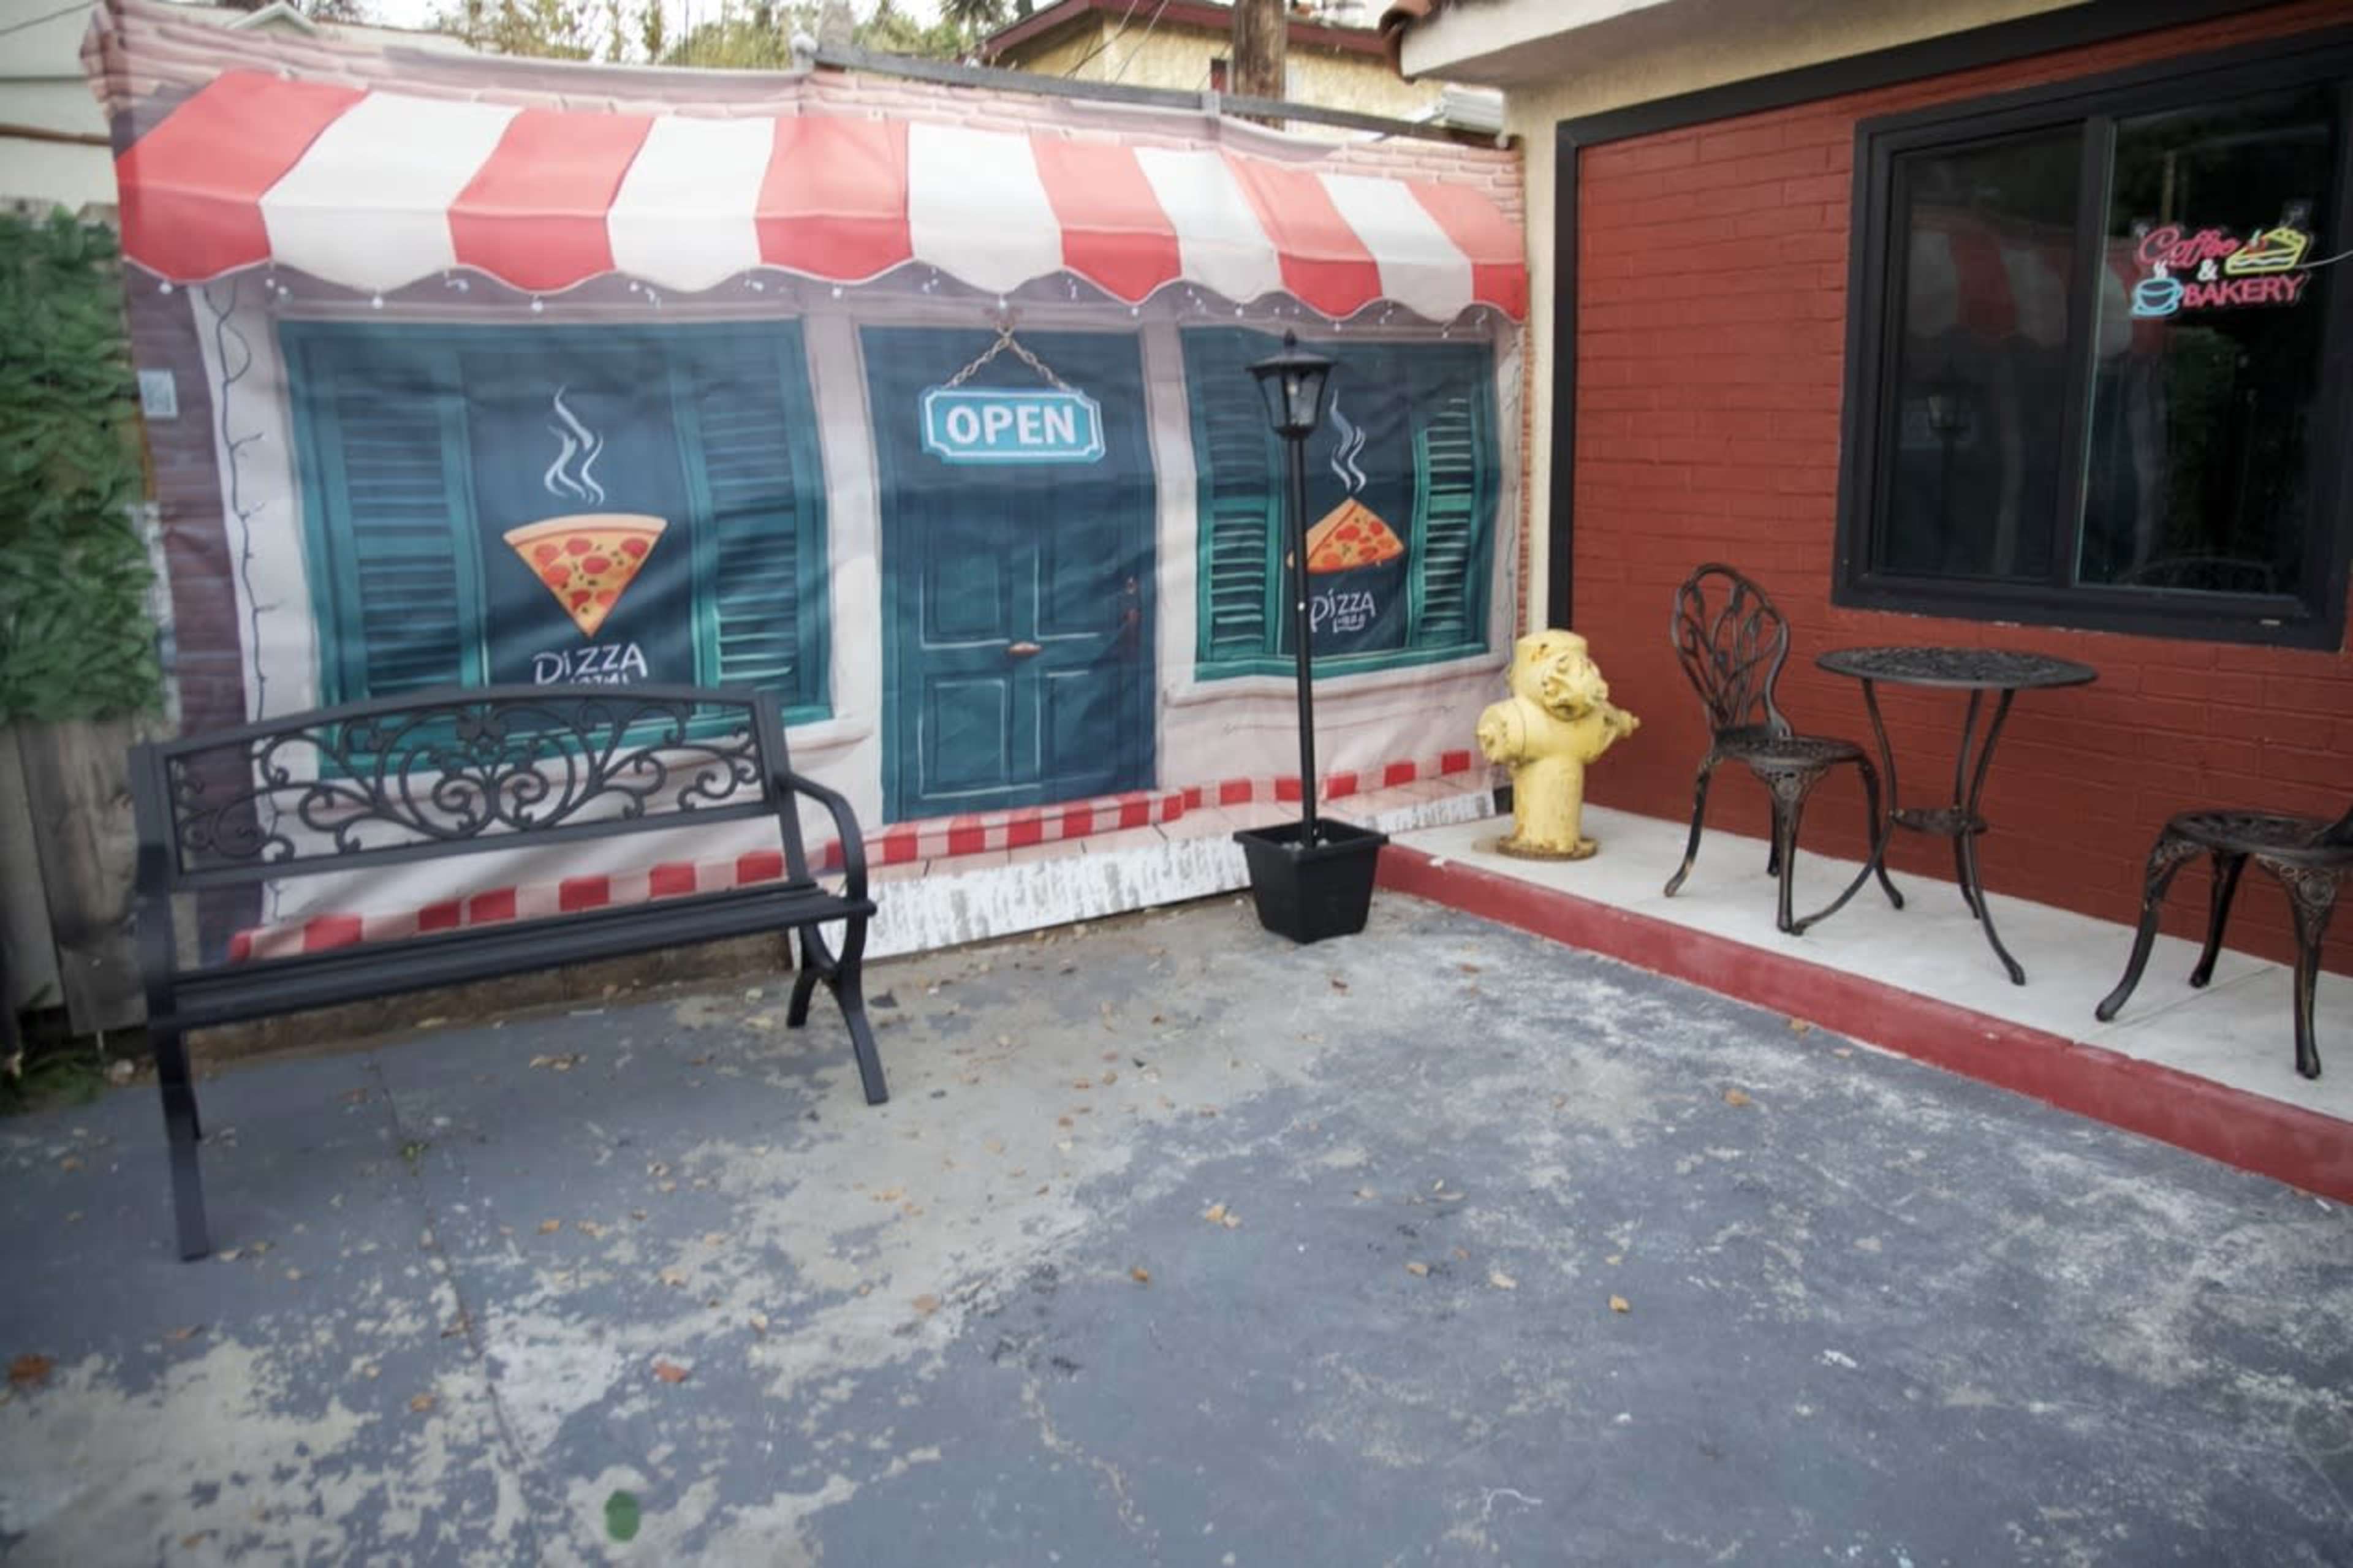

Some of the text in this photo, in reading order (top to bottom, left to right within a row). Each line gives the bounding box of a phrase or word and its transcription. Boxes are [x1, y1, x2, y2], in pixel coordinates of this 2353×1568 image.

[2139, 226, 2240, 268] Coffee
[2196, 258, 2220, 281] &
[2182, 273, 2303, 306] BAKERY
[945, 404, 1076, 445] OPEN
